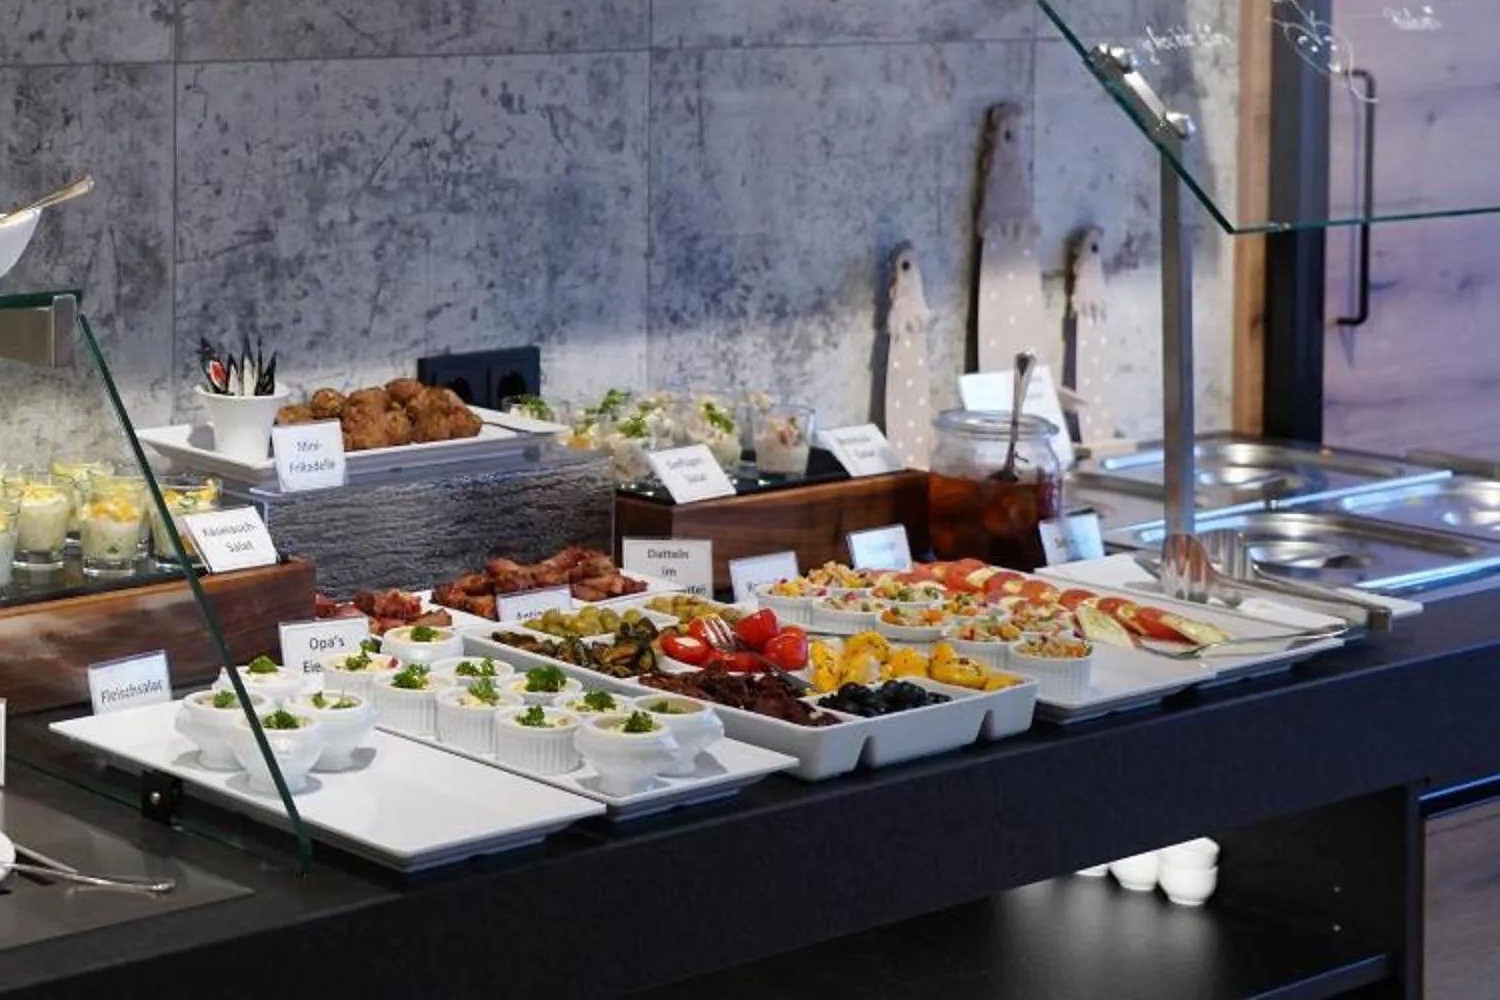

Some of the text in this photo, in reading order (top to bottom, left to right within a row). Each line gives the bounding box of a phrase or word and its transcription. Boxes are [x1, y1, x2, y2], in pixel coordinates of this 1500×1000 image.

[647, 548, 690, 560] Datteln
[661, 565, 677, 577] im
[309, 635, 345, 652] Opa's
[303, 660, 321, 673] Eie
